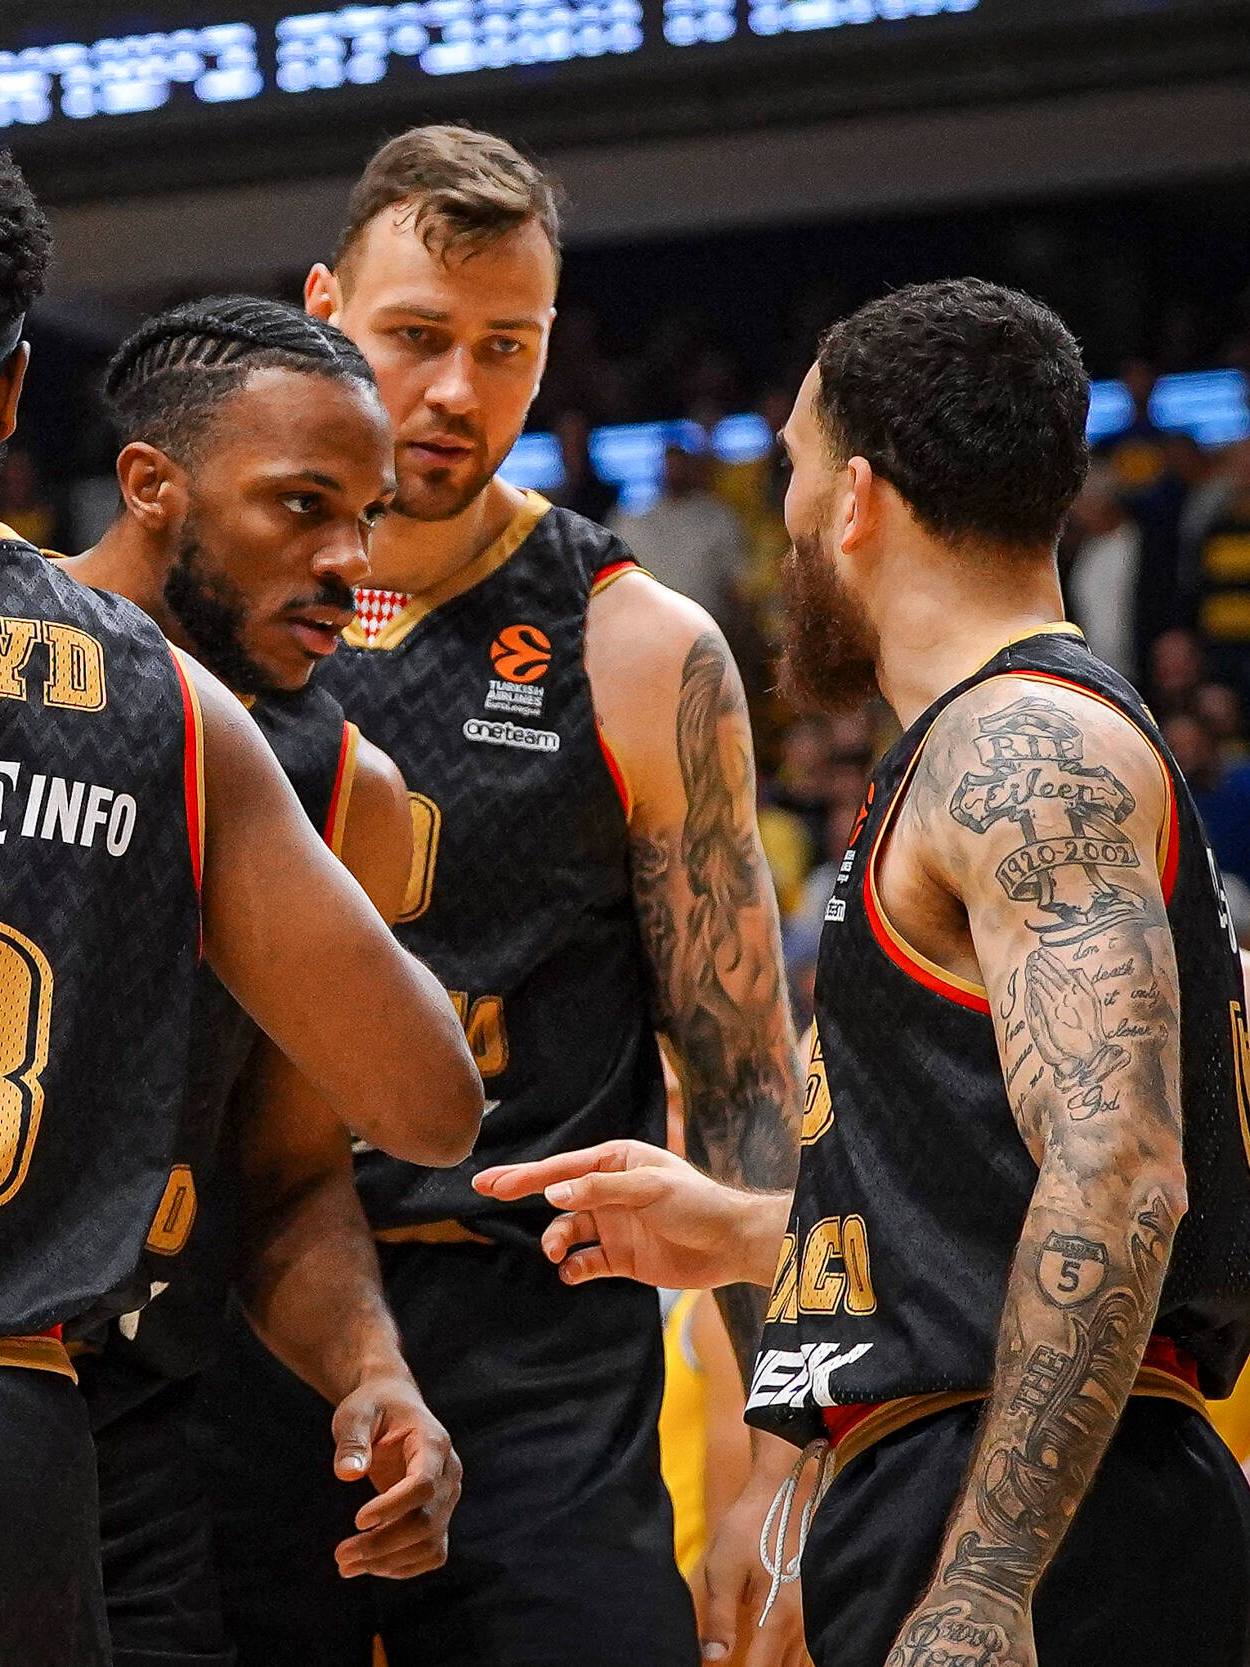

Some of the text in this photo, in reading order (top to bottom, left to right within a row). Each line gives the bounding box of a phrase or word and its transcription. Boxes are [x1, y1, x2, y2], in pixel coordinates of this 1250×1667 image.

[486, 690, 544, 707] AIRLINES
[488, 680, 545, 697] TURKISH
[988, 735, 1075, 760] RIP
[21, 774, 137, 857] INFO
[1002, 841, 1133, 885] 1920-2002
[1057, 1260, 1082, 1293] 5
